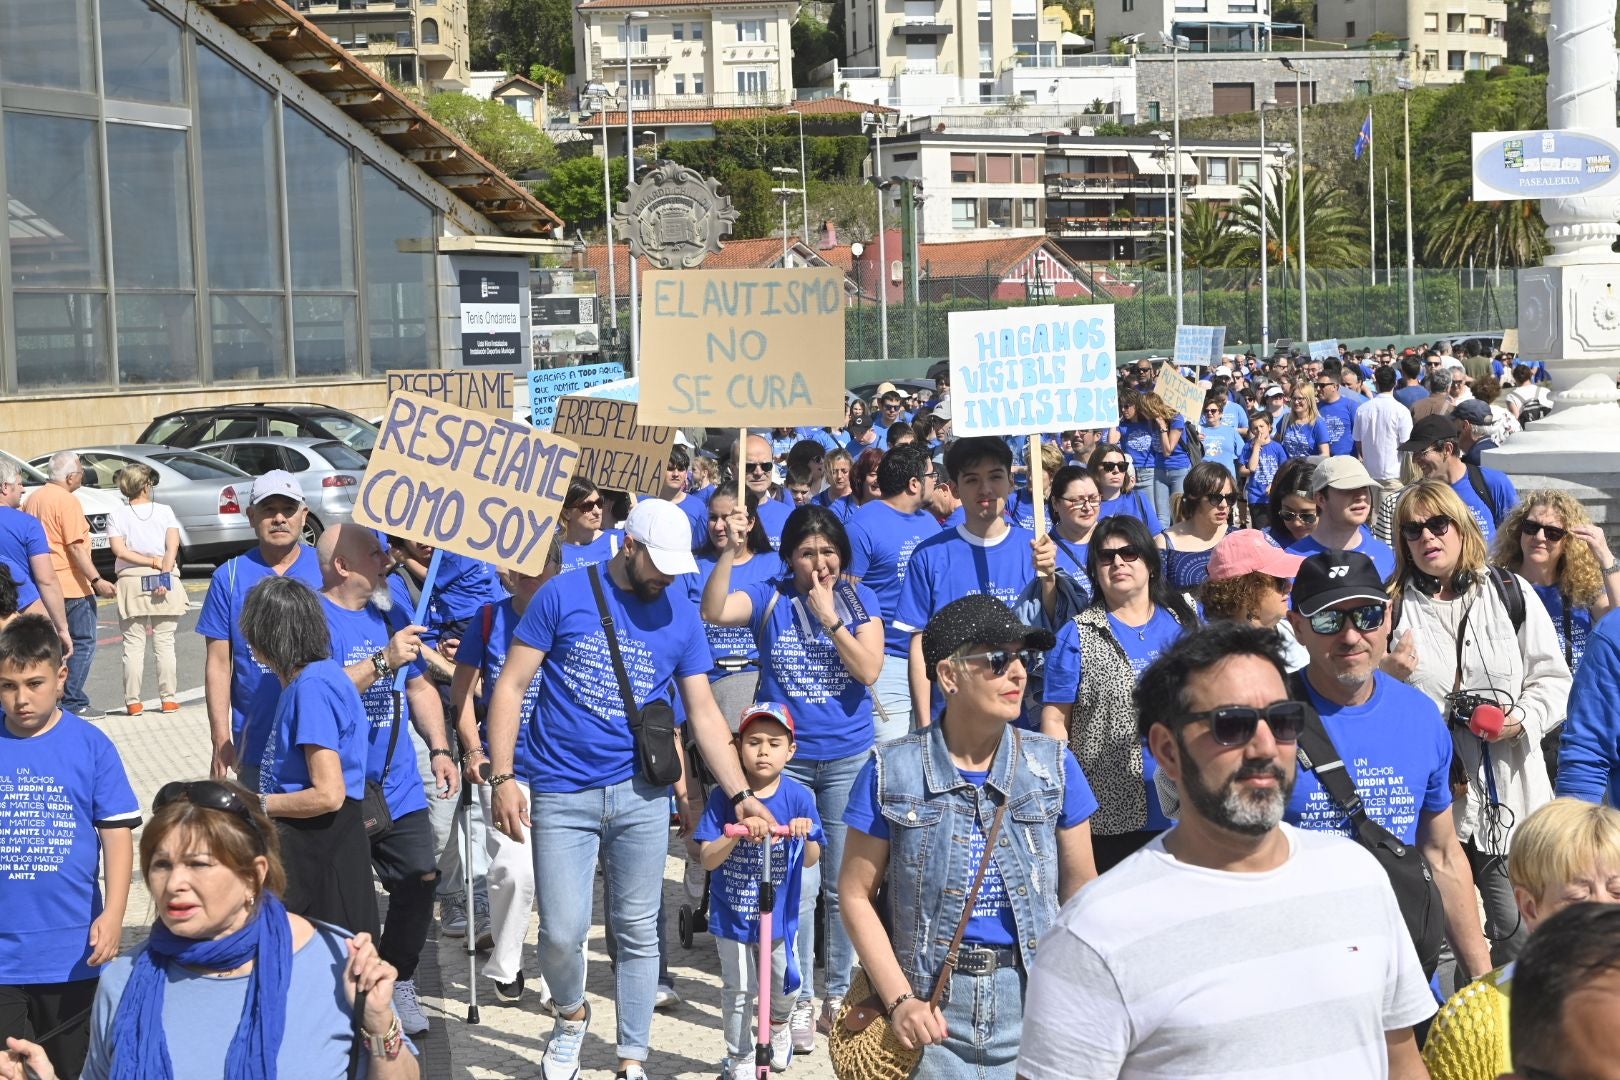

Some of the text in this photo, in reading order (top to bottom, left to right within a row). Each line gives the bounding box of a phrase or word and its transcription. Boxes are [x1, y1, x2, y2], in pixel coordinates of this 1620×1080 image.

[1519, 177, 1580, 186] PASEALEKUA
[655, 277, 839, 318] EL AUTISMO
[466, 311, 484, 324] Tenis
[485, 311, 517, 324] Ondarreta
[975, 318, 1105, 361] HAGAMOS
[706, 327, 768, 363] NO
[569, 371, 576, 379] A
[577, 369, 597, 378] TODO
[959, 351, 1111, 393] VISIBLE LO
[535, 386, 549, 394] QUE
[584, 380, 599, 389] QUE
[668, 371, 812, 414] SE CURA
[534, 406, 552, 415] PERO
[964, 387, 1118, 428] INVISIBLE
[535, 418, 550, 426] QUE
[601, 450, 662, 496] BEZALA
[363, 469, 553, 564] COMO SOY
[594, 630, 646, 648] AZU MUCHOS
[575, 641, 598, 652] URDIN
[584, 635, 652, 657] MATICE RDIN BAT
[566, 653, 579, 661] BAT
[581, 659, 603, 669] URDIN
[570, 647, 656, 674] MUCHOS URDIN
[634, 680, 653, 689] URDIN
[1357, 767, 1393, 776] MUCHOS
[18, 776, 54, 784] MUCHOS
[1358, 776, 1403, 786] URDIN BAT
[1391, 787, 1411, 795] AZUL
[48, 795, 69, 803] AZUL
[1364, 796, 1414, 806] TICES URDIN
[47, 803, 73, 811] URDIN
[1384, 807, 1396, 815] UN
[56, 812, 75, 820] AZUL
[972, 909, 997, 917] ANITZ
